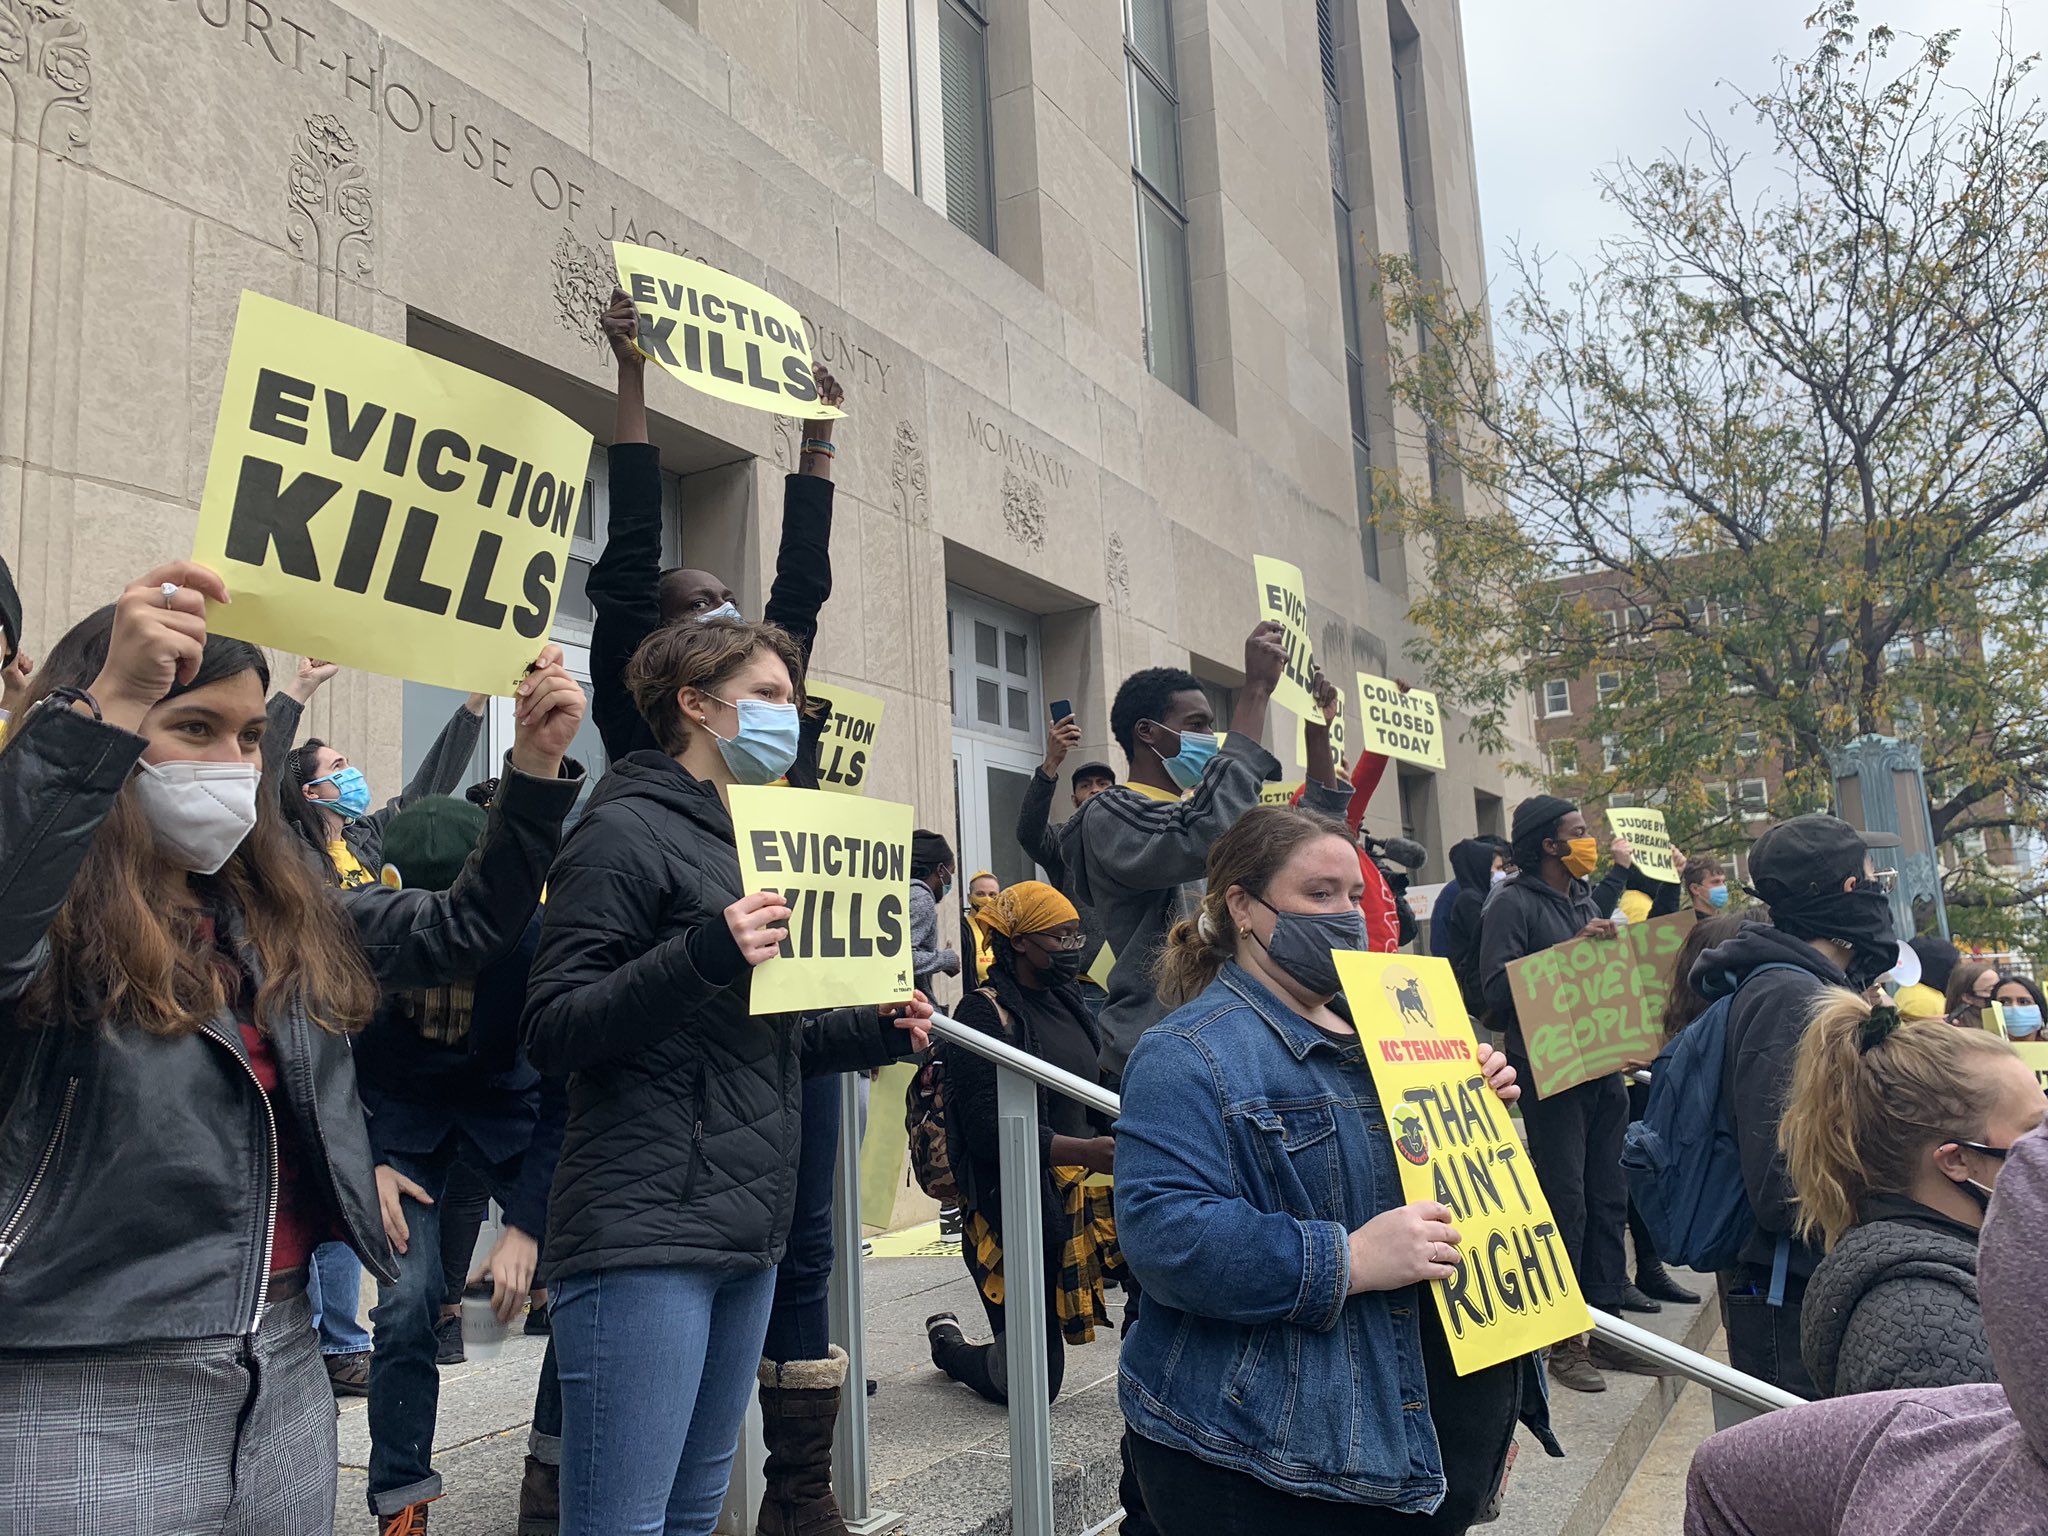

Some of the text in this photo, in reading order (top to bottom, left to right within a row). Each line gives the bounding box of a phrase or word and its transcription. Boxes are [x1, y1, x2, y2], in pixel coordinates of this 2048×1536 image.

[530, 166, 585, 222] OF
[630, 273, 807, 355] EVICTION
[638, 313, 818, 402] KILLS
[249, 368, 575, 538] EVICTION
[967, 411, 1073, 489] MCMXXXIV
[225, 455, 557, 639] KILLS
[1271, 619, 1313, 694] ILLS
[1363, 684, 1434, 716] COURT'S
[1369, 705, 1434, 735] CLOSED
[816, 741, 866, 787] LLS
[1376, 728, 1430, 755] TODAY
[750, 830, 904, 882] EVICTION
[1616, 817, 1653, 830] JUDGE
[1632, 849, 1673, 870] HE LAW
[1520, 923, 1683, 1000] PROFITS
[1552, 960, 1670, 1013] OVER
[1530, 994, 1665, 1071] PEOPLE
[1402, 1074, 1501, 1149] THAT
[1431, 1143, 1533, 1221] AIN'T
[1440, 1222, 1568, 1339] RIGHT
